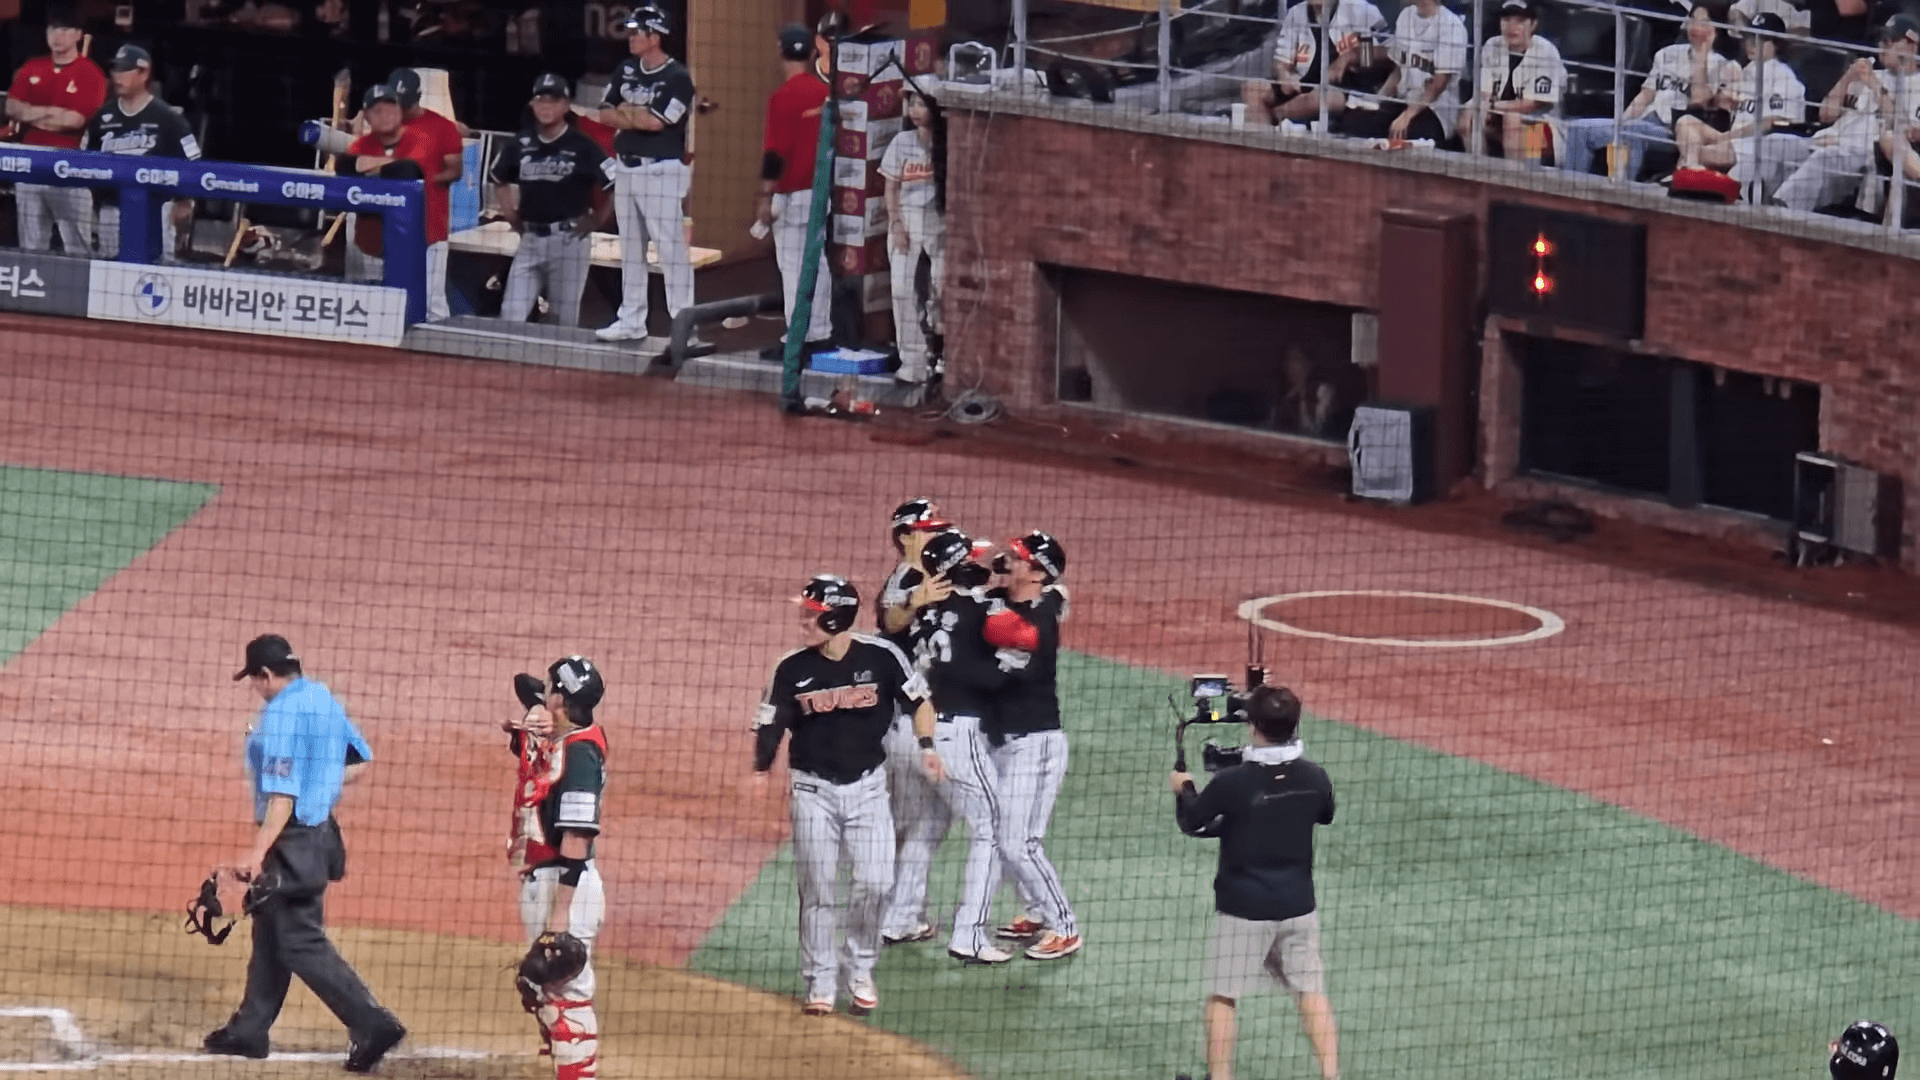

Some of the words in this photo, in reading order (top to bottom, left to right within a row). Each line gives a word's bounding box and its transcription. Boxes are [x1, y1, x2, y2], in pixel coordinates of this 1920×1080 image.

[183, 285, 286, 322] 바바리안
[292, 295, 369, 327] 모터스
[795, 683, 878, 714] TWINS
